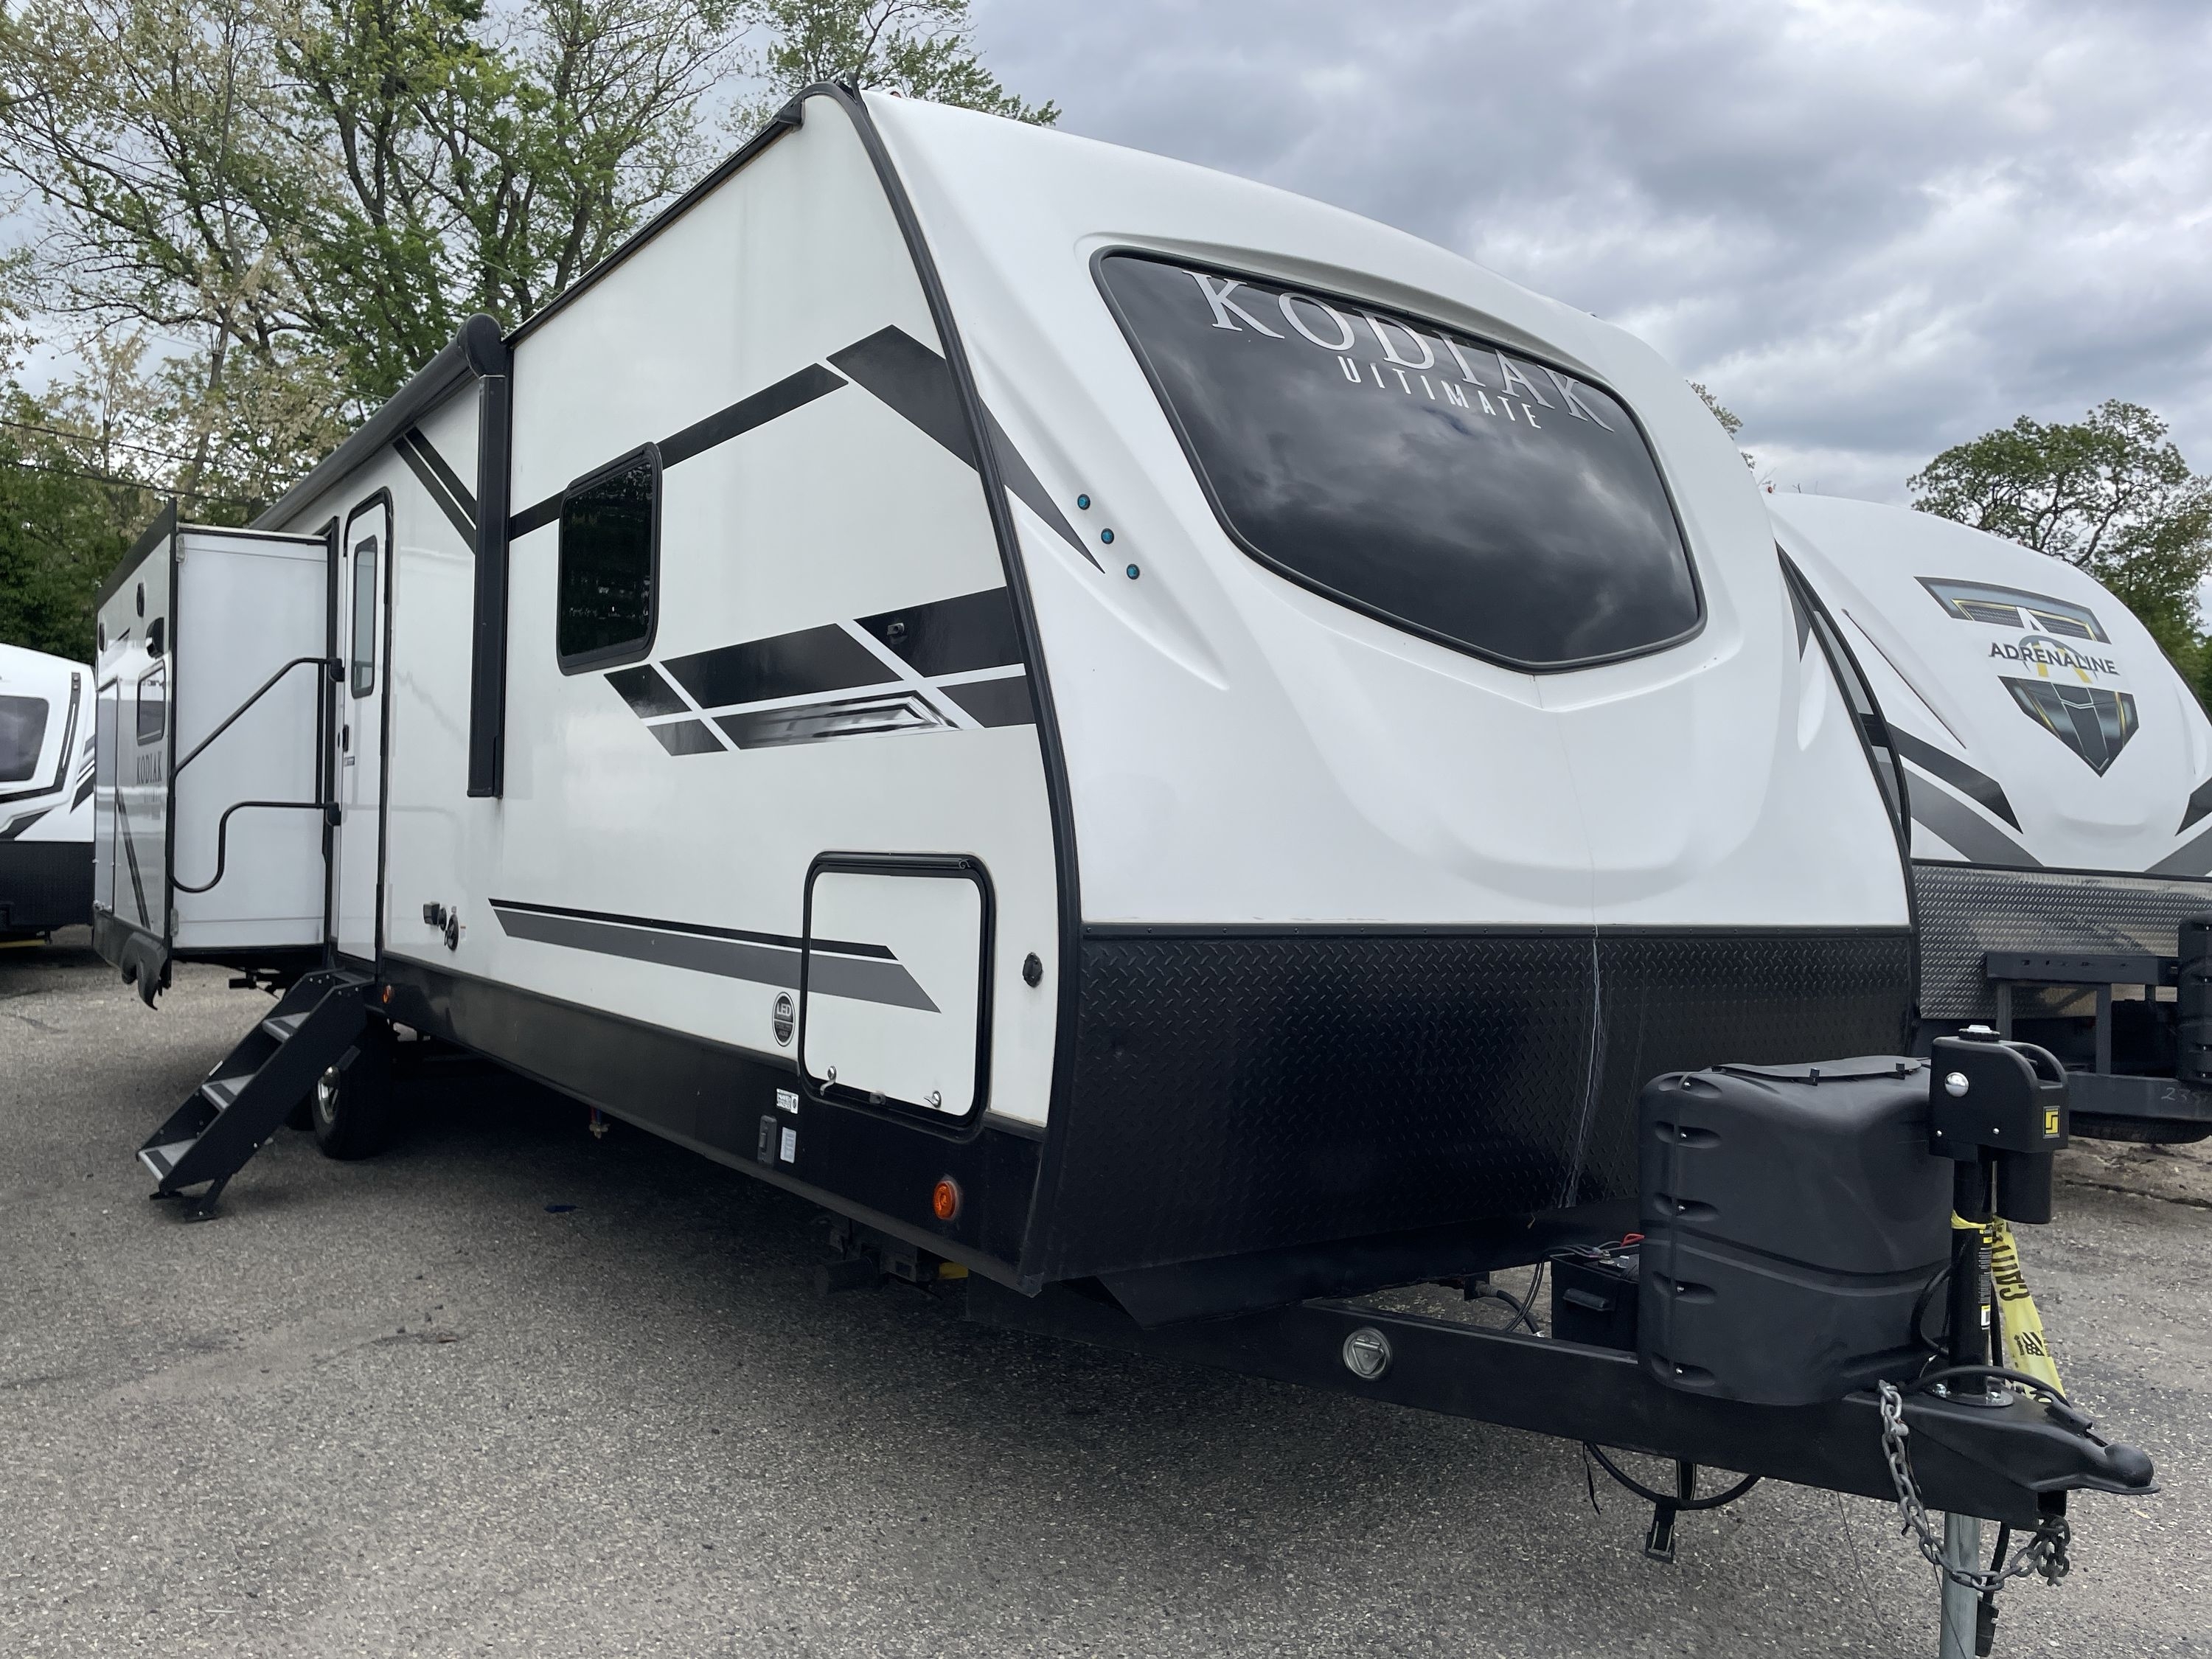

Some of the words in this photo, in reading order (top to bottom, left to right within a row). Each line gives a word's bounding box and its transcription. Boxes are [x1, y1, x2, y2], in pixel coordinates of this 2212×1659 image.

[1182, 269, 1614, 433] KODIAK
[1989, 642, 2120, 675] ADRENALINE
[136, 751, 162, 785] KODIAK
[776, 1002, 792, 1017] LED
